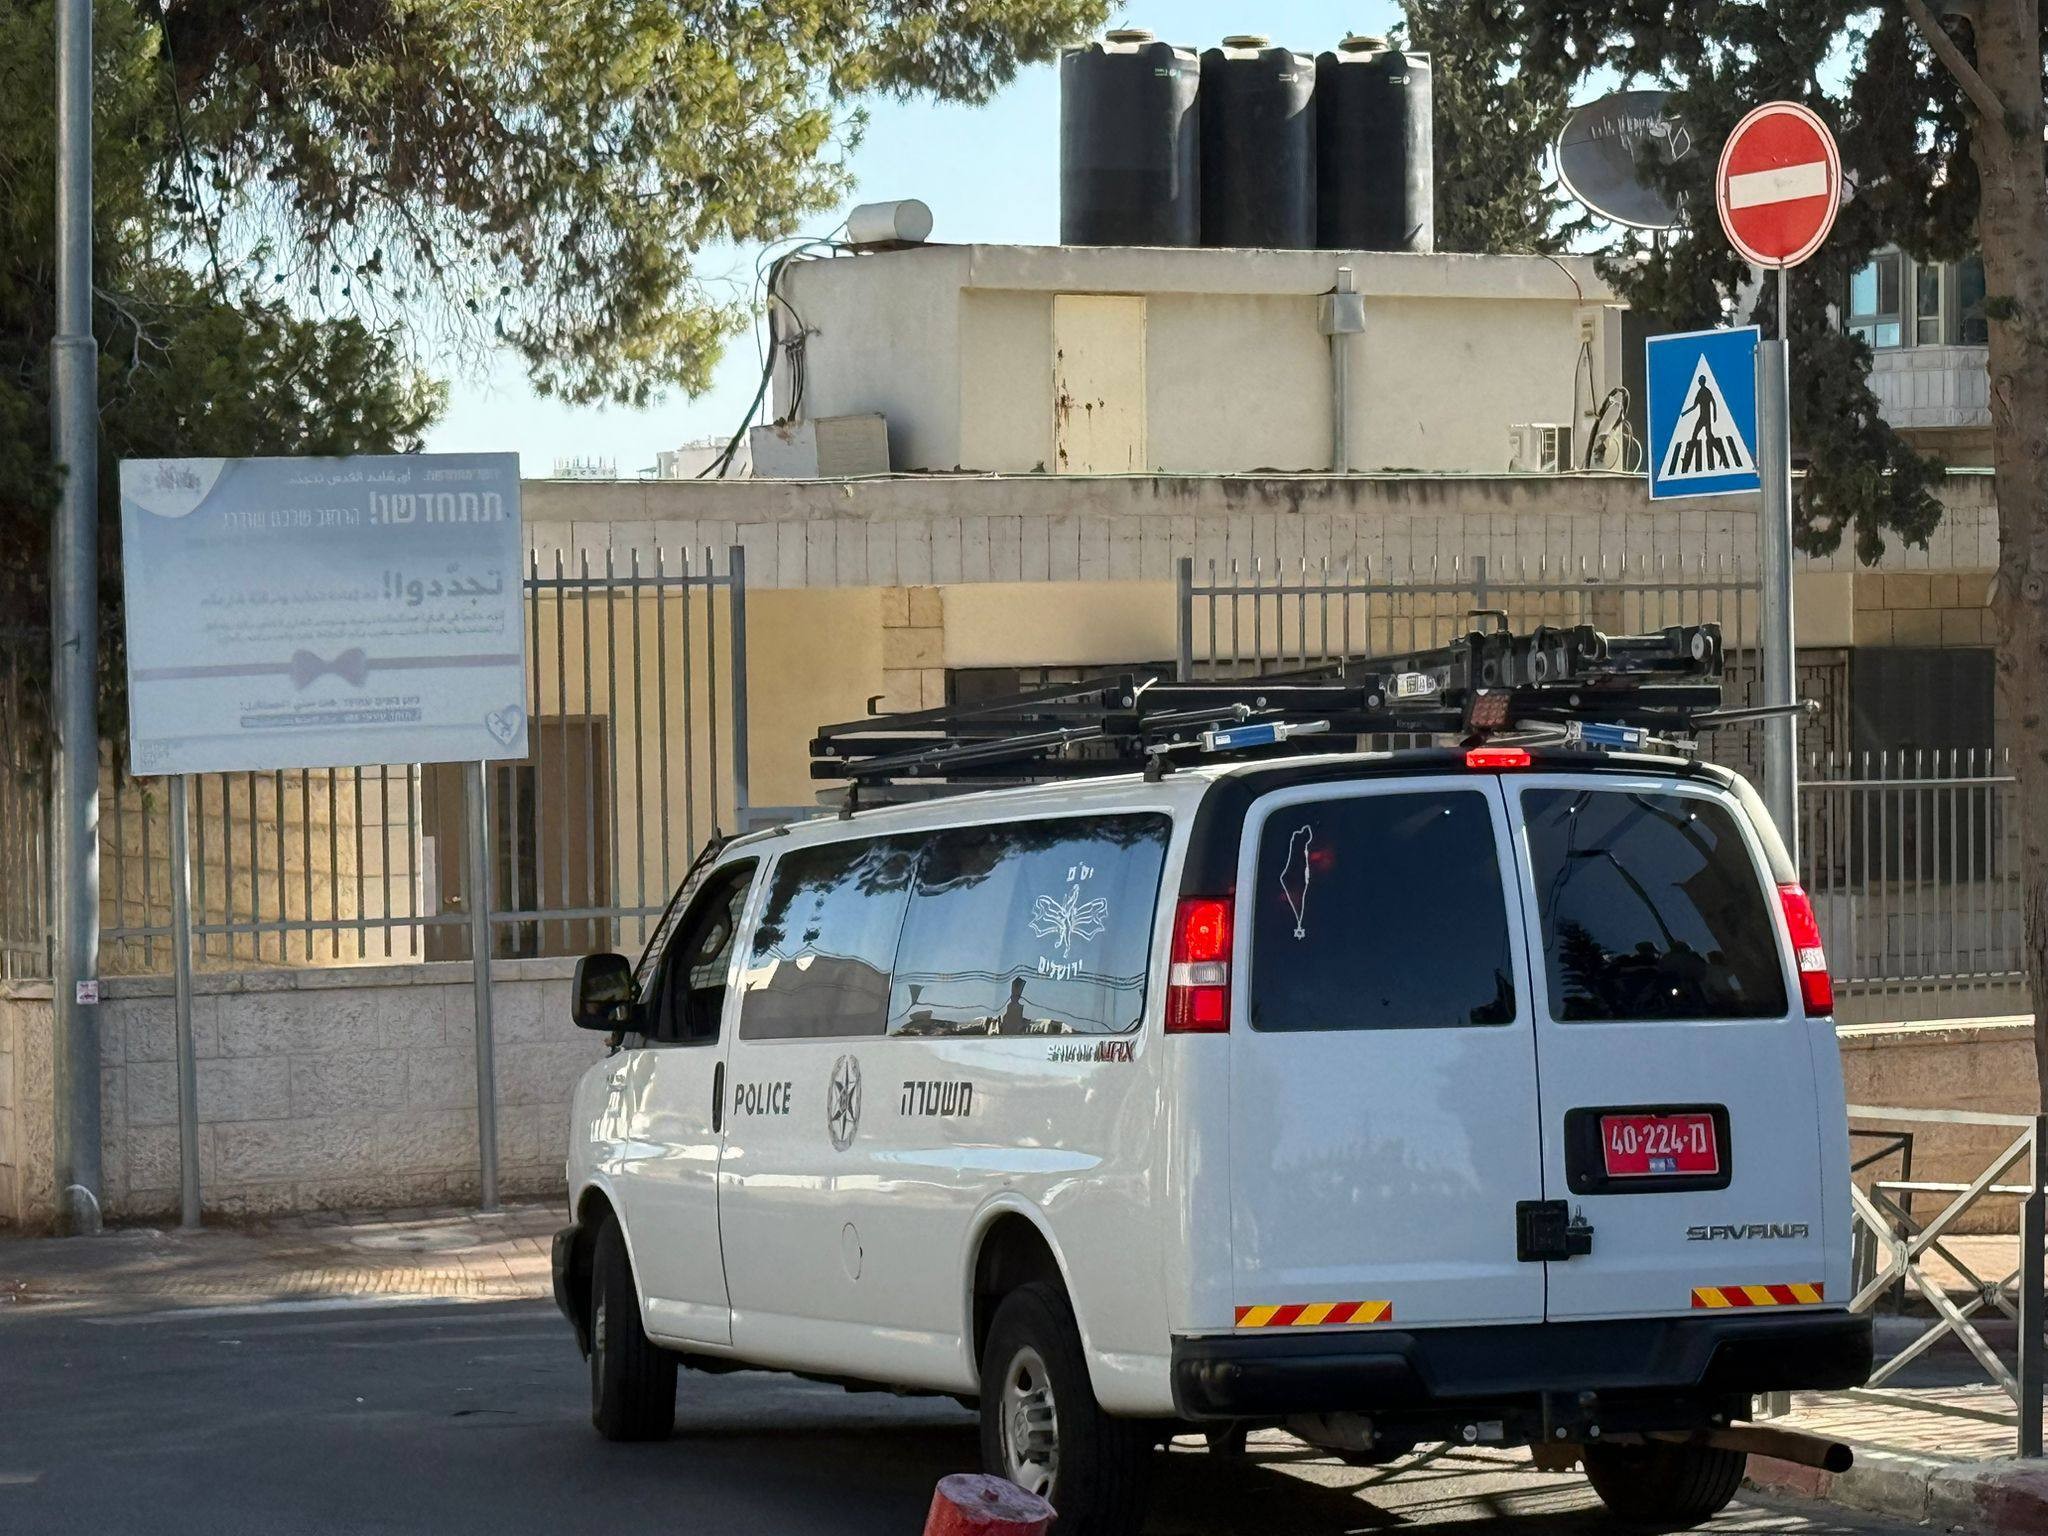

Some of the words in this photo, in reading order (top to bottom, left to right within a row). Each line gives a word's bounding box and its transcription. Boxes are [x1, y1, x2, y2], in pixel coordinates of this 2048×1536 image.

[369, 491, 502, 524] תתחדשו!
[1038, 955, 1083, 981] ירושלים
[733, 1081, 792, 1116] POLICE
[901, 1081, 973, 1117] משטרה
[1686, 1223, 1809, 1240] SAVANA
